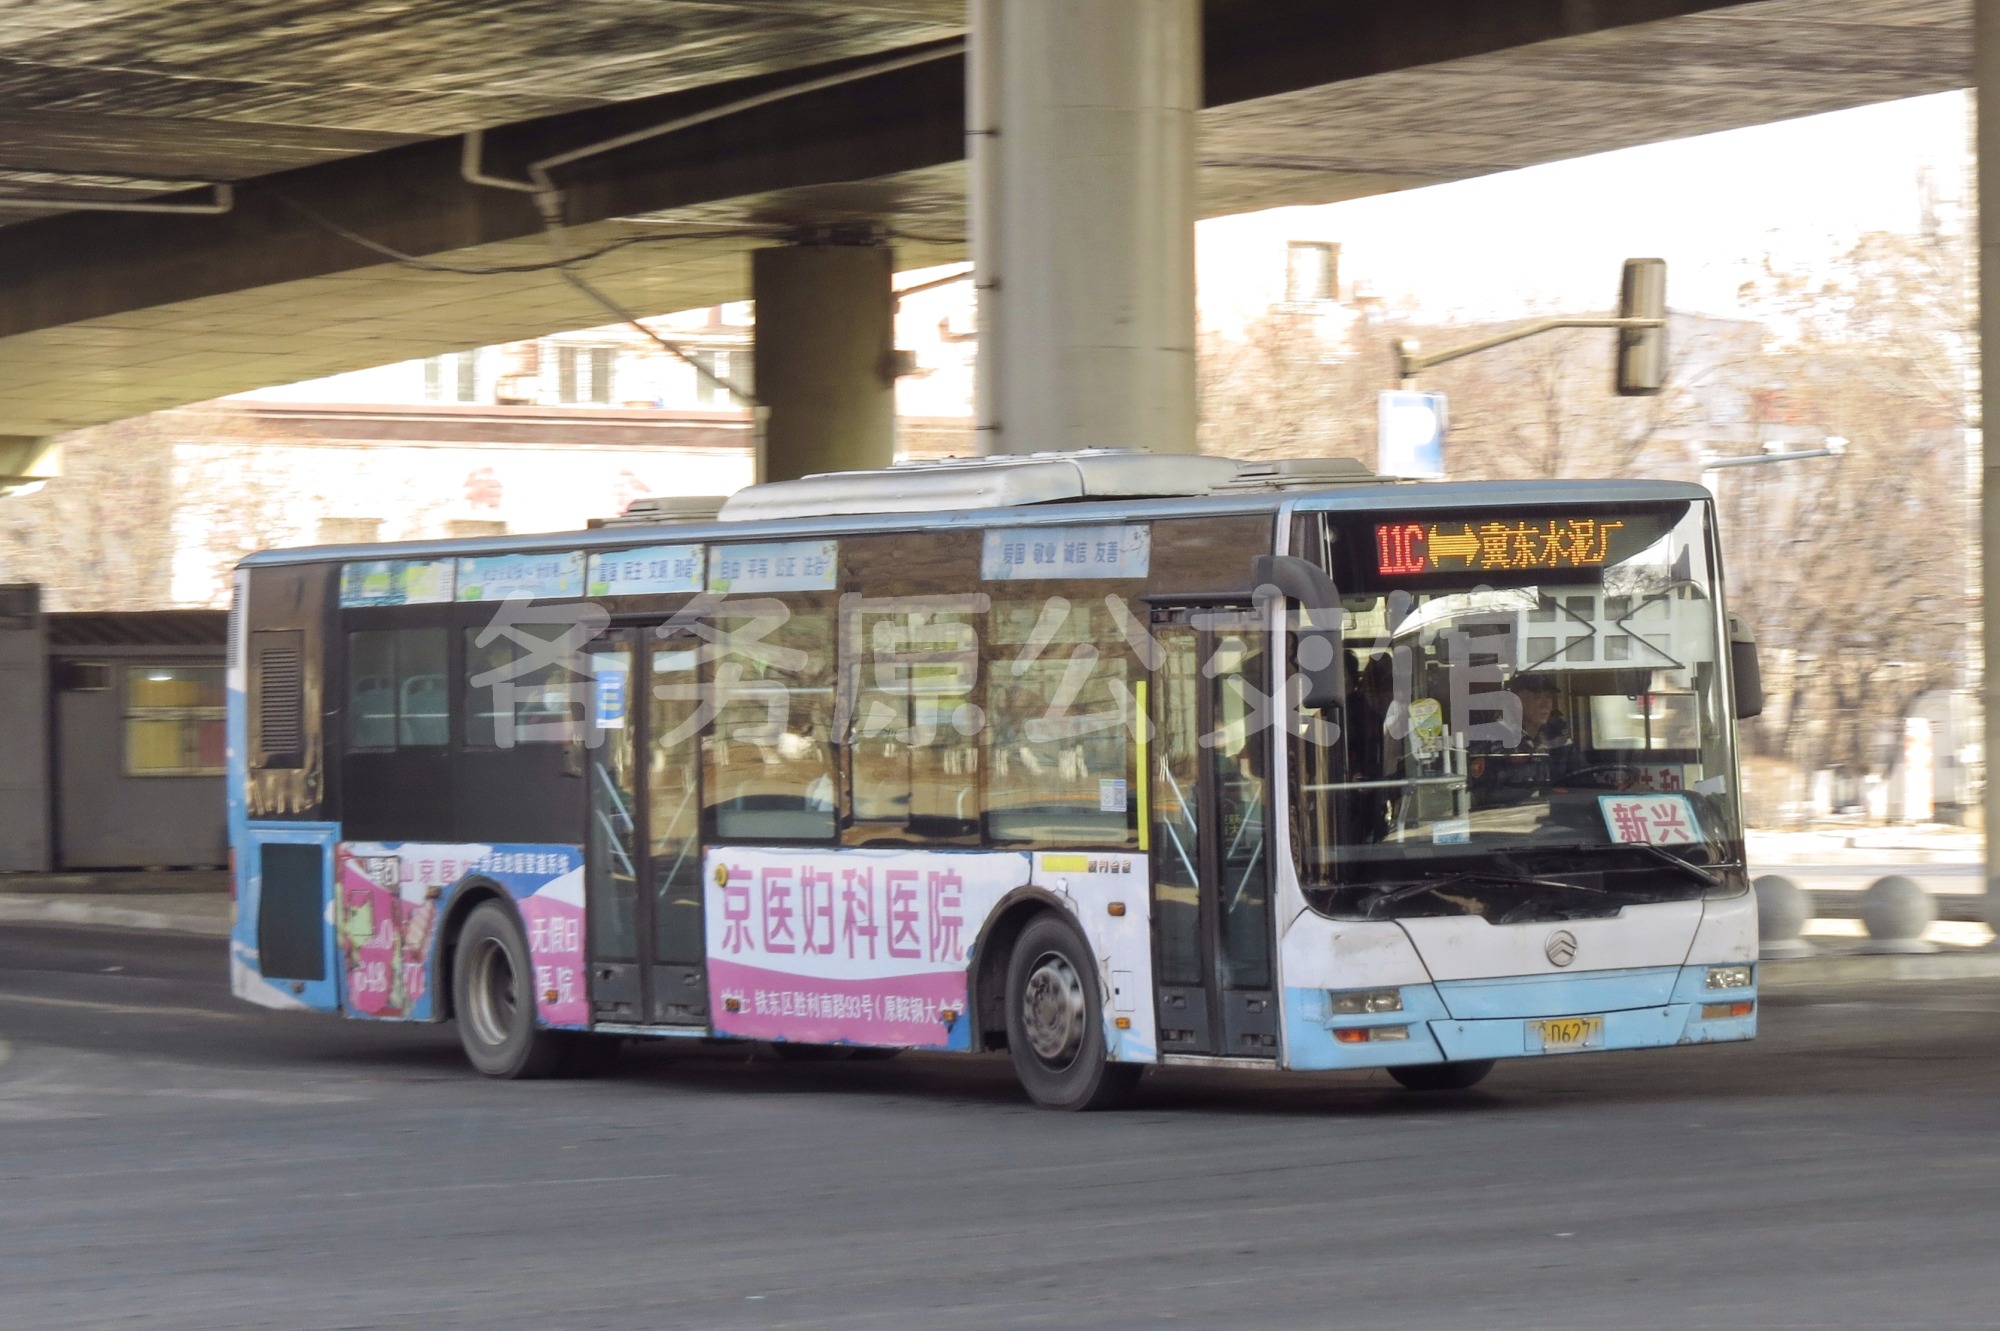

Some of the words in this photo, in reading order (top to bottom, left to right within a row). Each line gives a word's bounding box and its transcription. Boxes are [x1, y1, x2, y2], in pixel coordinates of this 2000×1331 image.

[1095, 541, 1119, 563] 友善
[1377, 523, 1425, 575] 11C
[1479, 518, 1625, 569] 冀东水泥厂
[1612, 803, 1690, 844] 新兴
[722, 864, 966, 963] 京医妇科医院
[531, 917, 579, 953] 无假日
